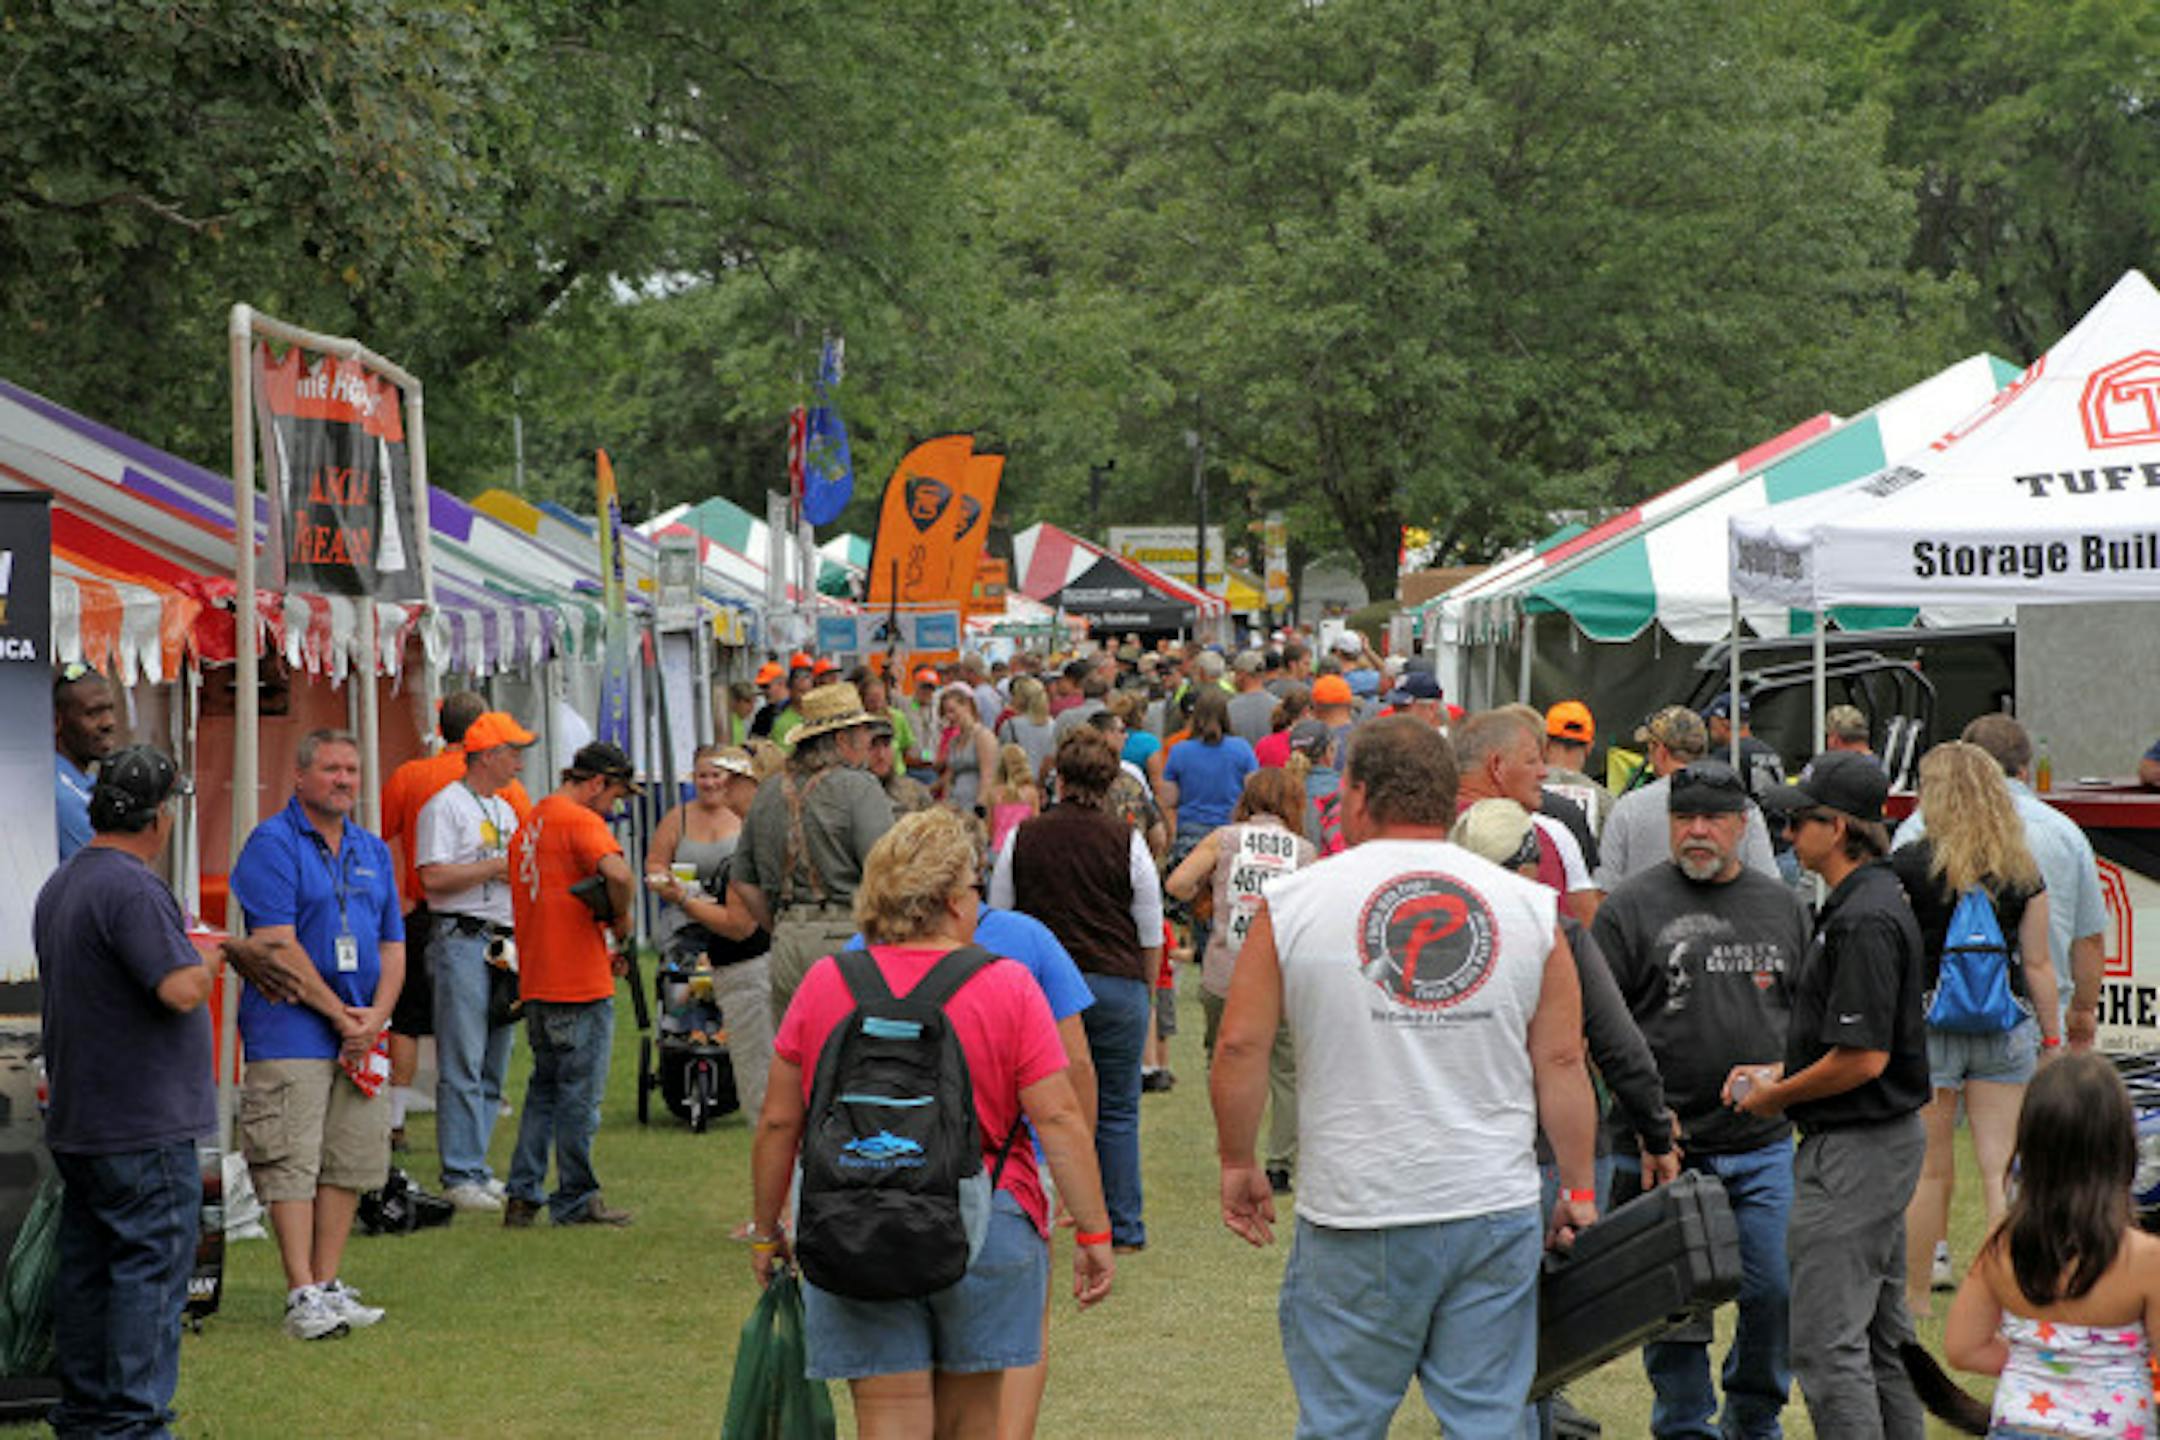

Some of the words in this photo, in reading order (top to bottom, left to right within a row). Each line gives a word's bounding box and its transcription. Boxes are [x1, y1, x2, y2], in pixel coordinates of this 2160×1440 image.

[1913, 540, 2069, 579] Storage
[2081, 531, 2158, 573] Buil
[2096, 984, 2157, 1028] HE
